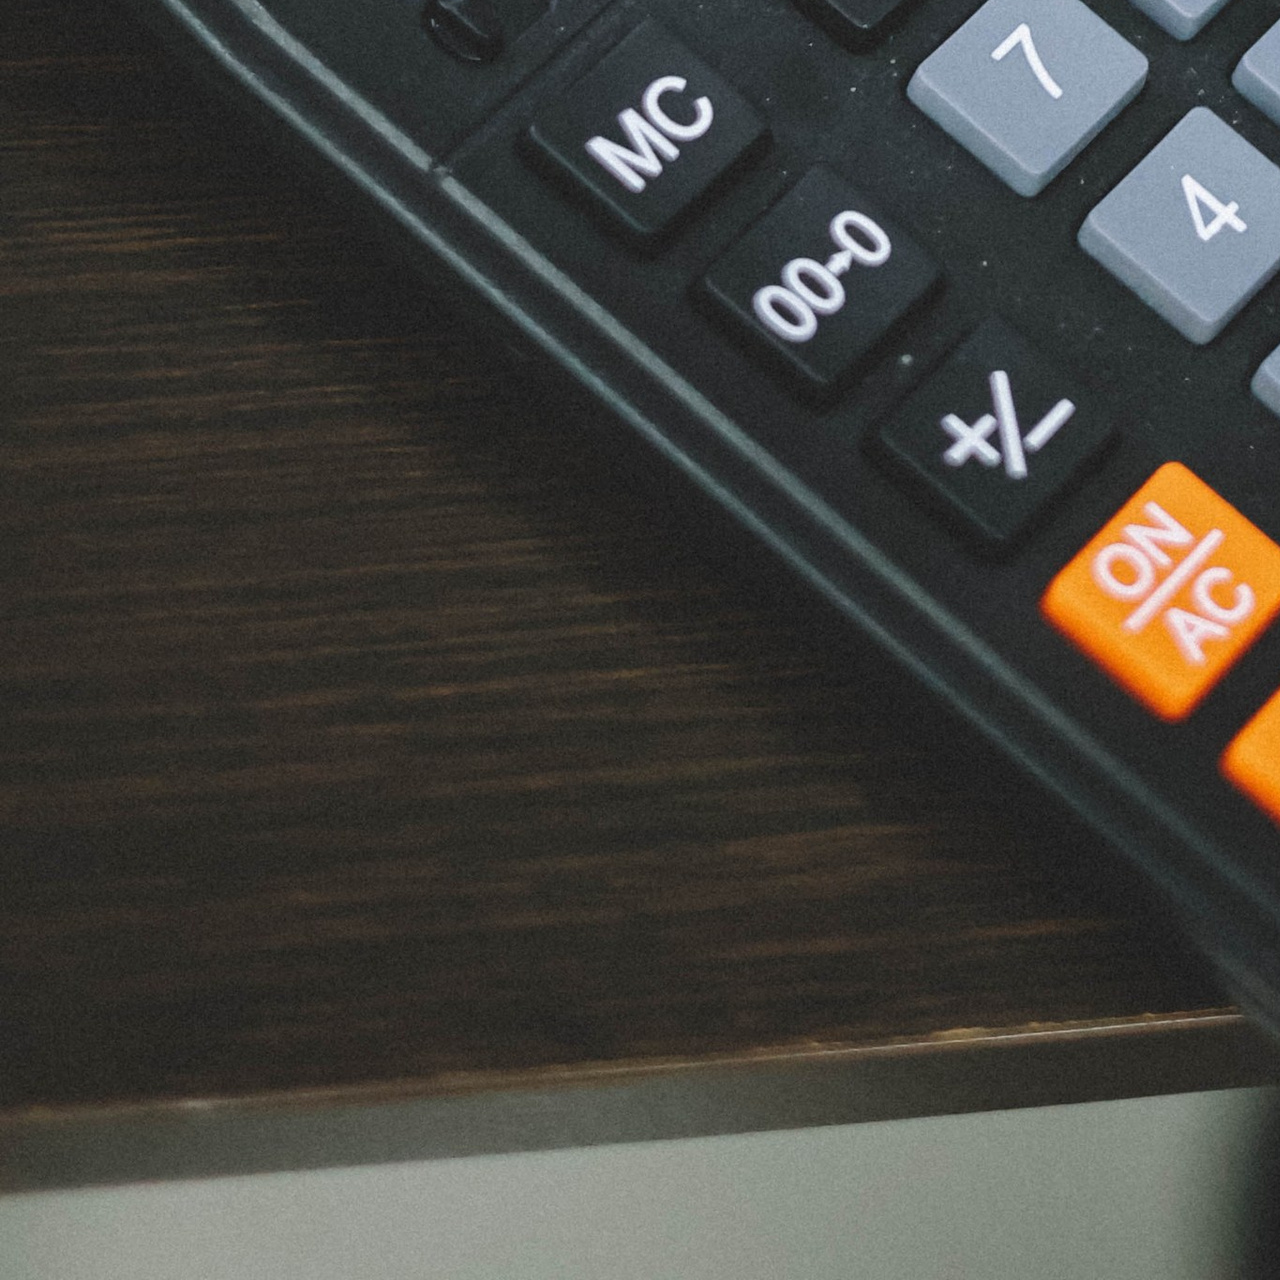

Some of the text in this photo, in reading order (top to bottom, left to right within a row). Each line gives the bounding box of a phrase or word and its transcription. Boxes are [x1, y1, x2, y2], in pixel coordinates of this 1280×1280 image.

[990, 22, 1064, 100] 7
[585, 74, 715, 192] MC
[1180, 173, 1248, 242] 4
[1092, 500, 1196, 602] ON
[1165, 566, 1256, 667] AC
